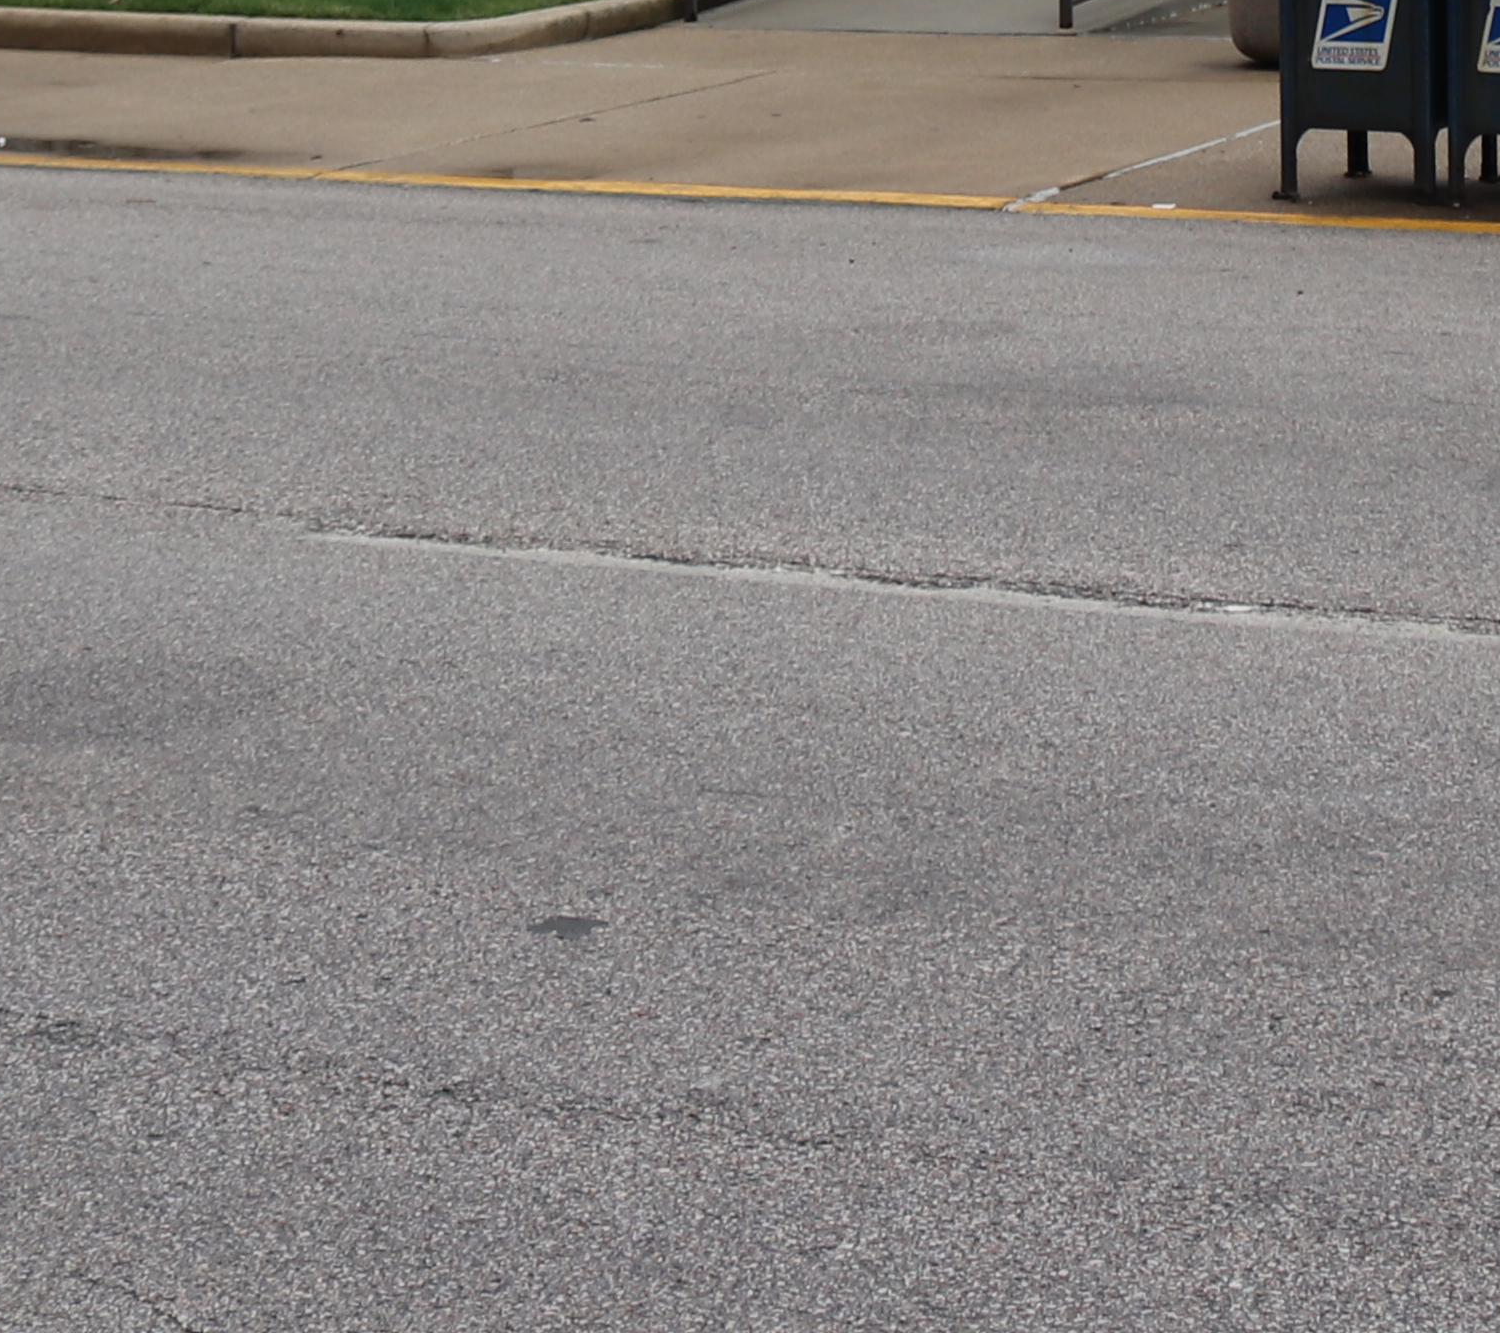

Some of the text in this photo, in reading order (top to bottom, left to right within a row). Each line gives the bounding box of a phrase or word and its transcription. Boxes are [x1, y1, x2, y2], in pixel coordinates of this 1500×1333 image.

[1317, 47, 1379, 56] UNITED STATES
[1316, 56, 1381, 65] POSTAL SERVICE
